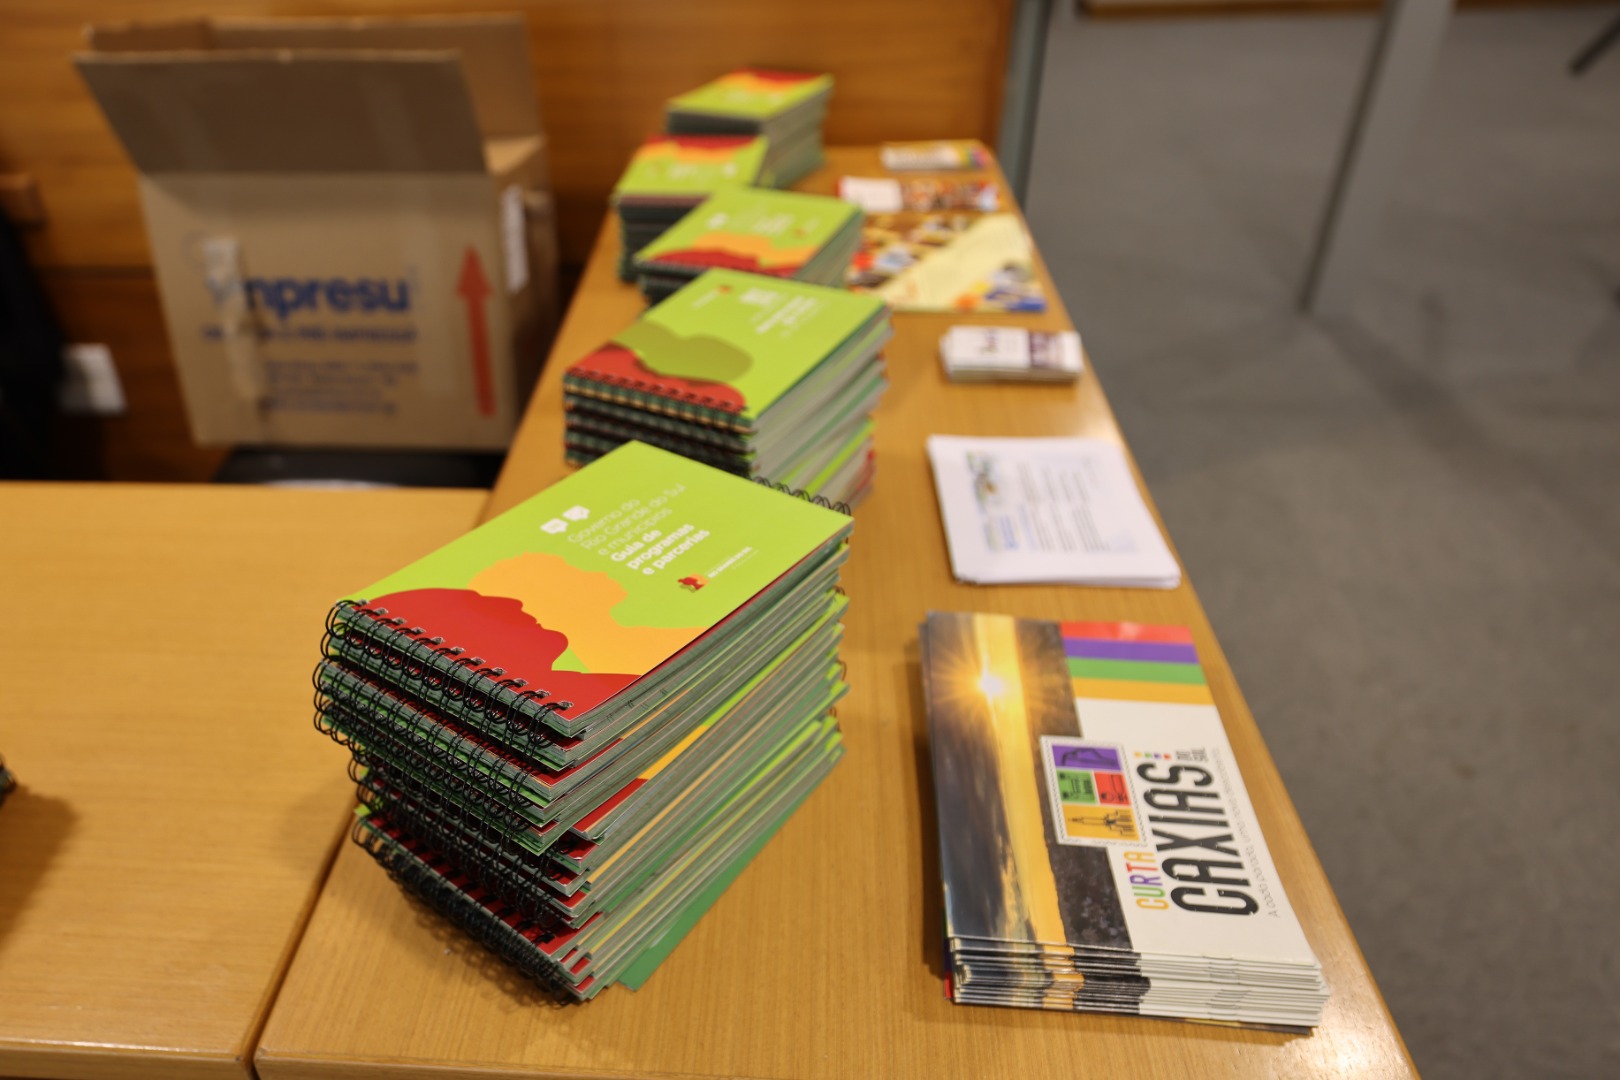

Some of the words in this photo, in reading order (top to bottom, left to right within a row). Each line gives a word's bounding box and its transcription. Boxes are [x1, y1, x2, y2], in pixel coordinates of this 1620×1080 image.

[567, 509, 623, 543] Governo
[620, 498, 641, 513] do
[580, 534, 608, 550] Rio
[603, 506, 651, 535] Grande
[648, 495, 668, 508] do
[662, 482, 686, 498] Sul
[598, 548, 610, 556] e
[610, 541, 645, 562] Guia
[641, 529, 662, 543] de
[626, 524, 694, 570] programas
[642, 567, 655, 575] e
[652, 529, 710, 570] parcerias
[1136, 762, 1260, 916] CAXIAS
[1123, 851, 1170, 911] CURTA
